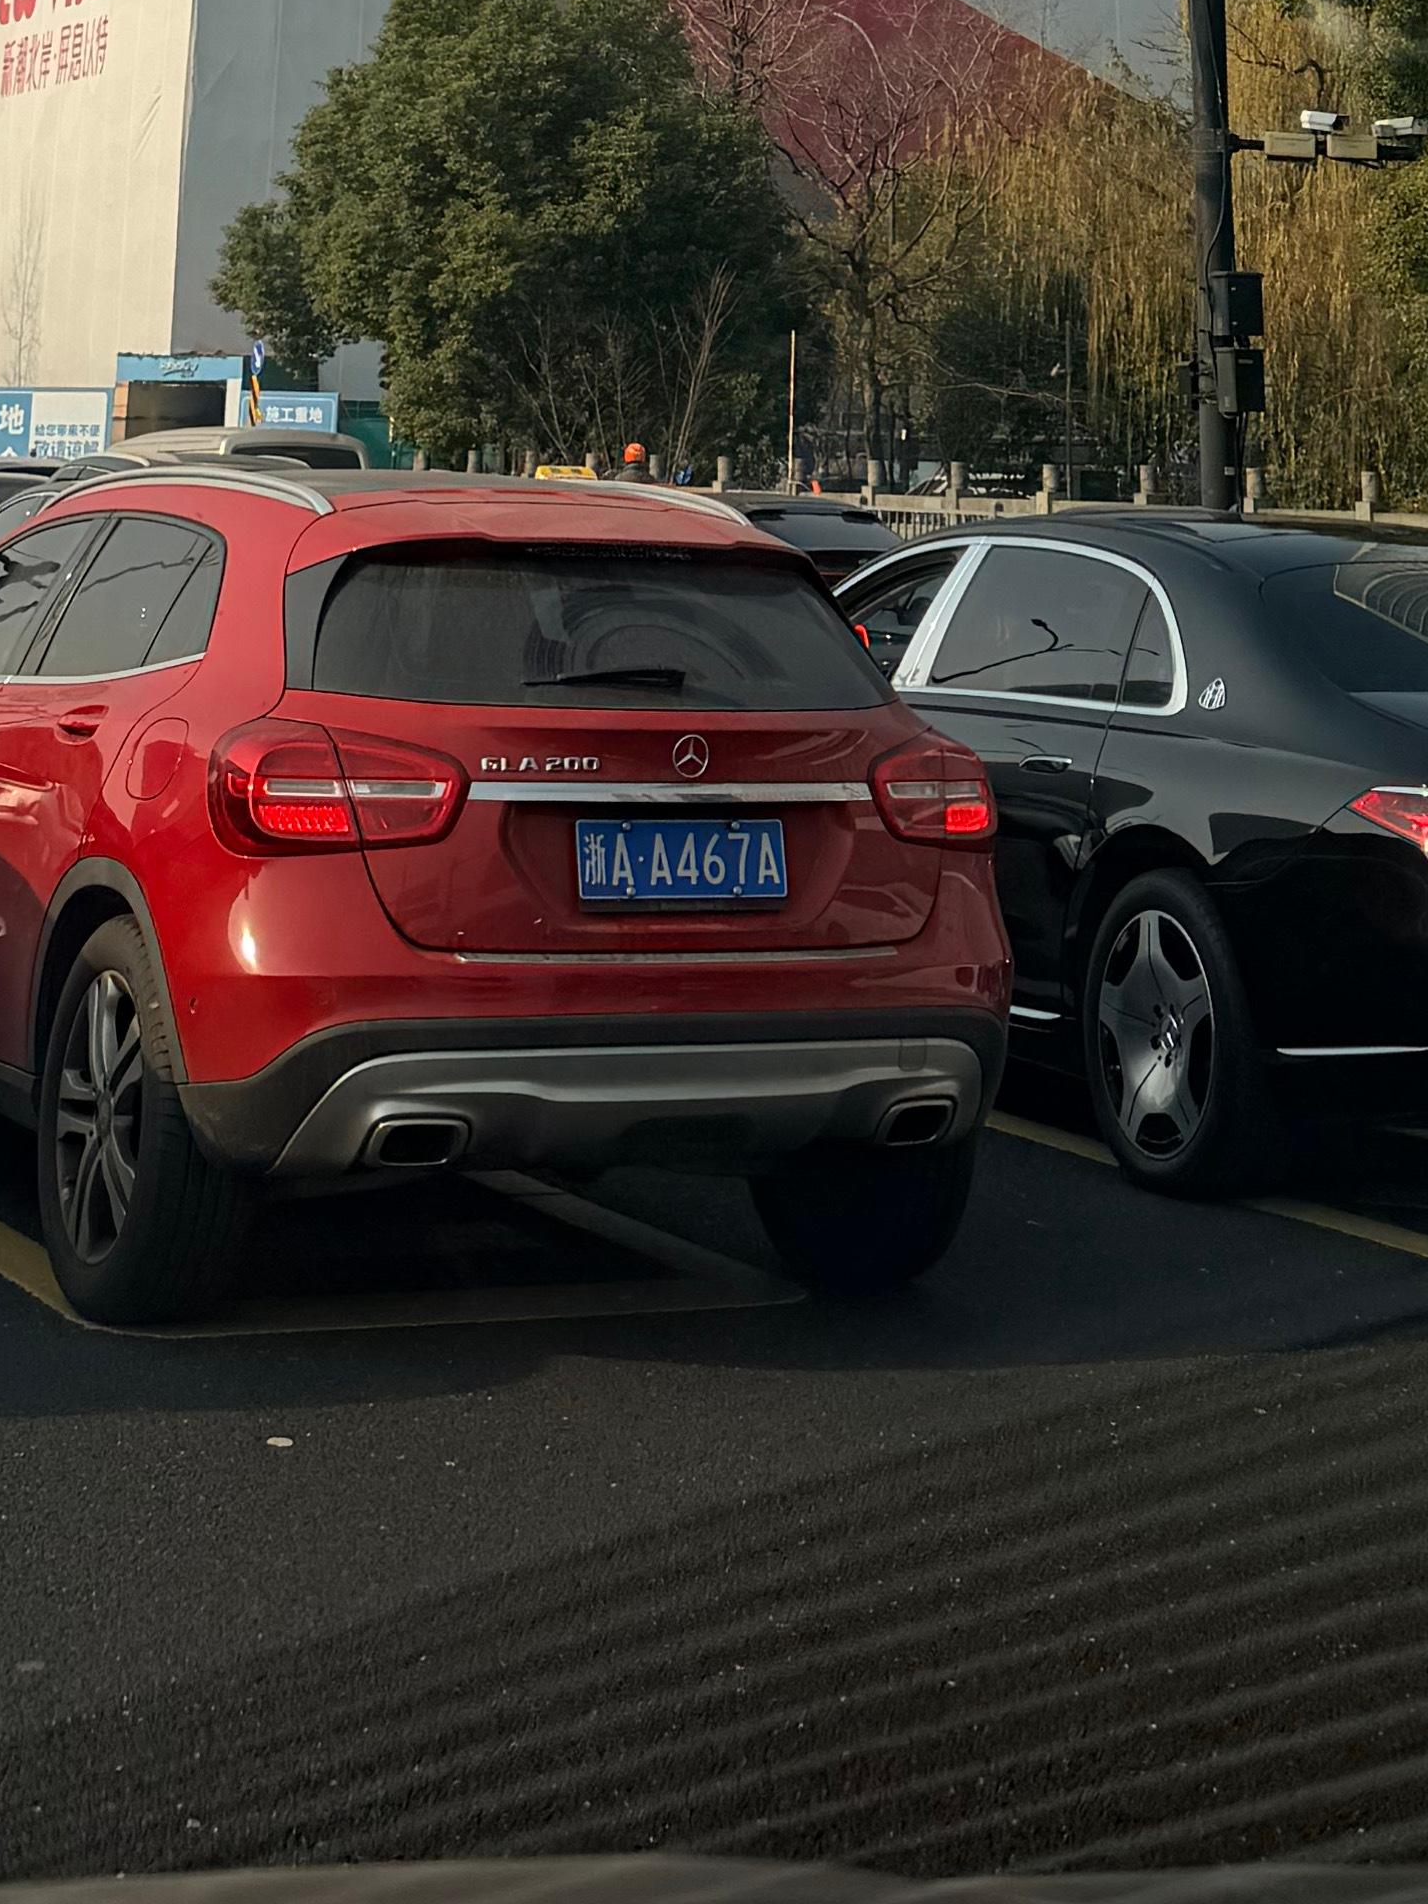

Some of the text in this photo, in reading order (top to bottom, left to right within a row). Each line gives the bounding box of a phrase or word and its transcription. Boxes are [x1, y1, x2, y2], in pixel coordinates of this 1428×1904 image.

[266, 406, 323, 424] 施工重地
[35, 423, 100, 437] 给您带来不便
[480, 756, 601, 772] GLA 200
